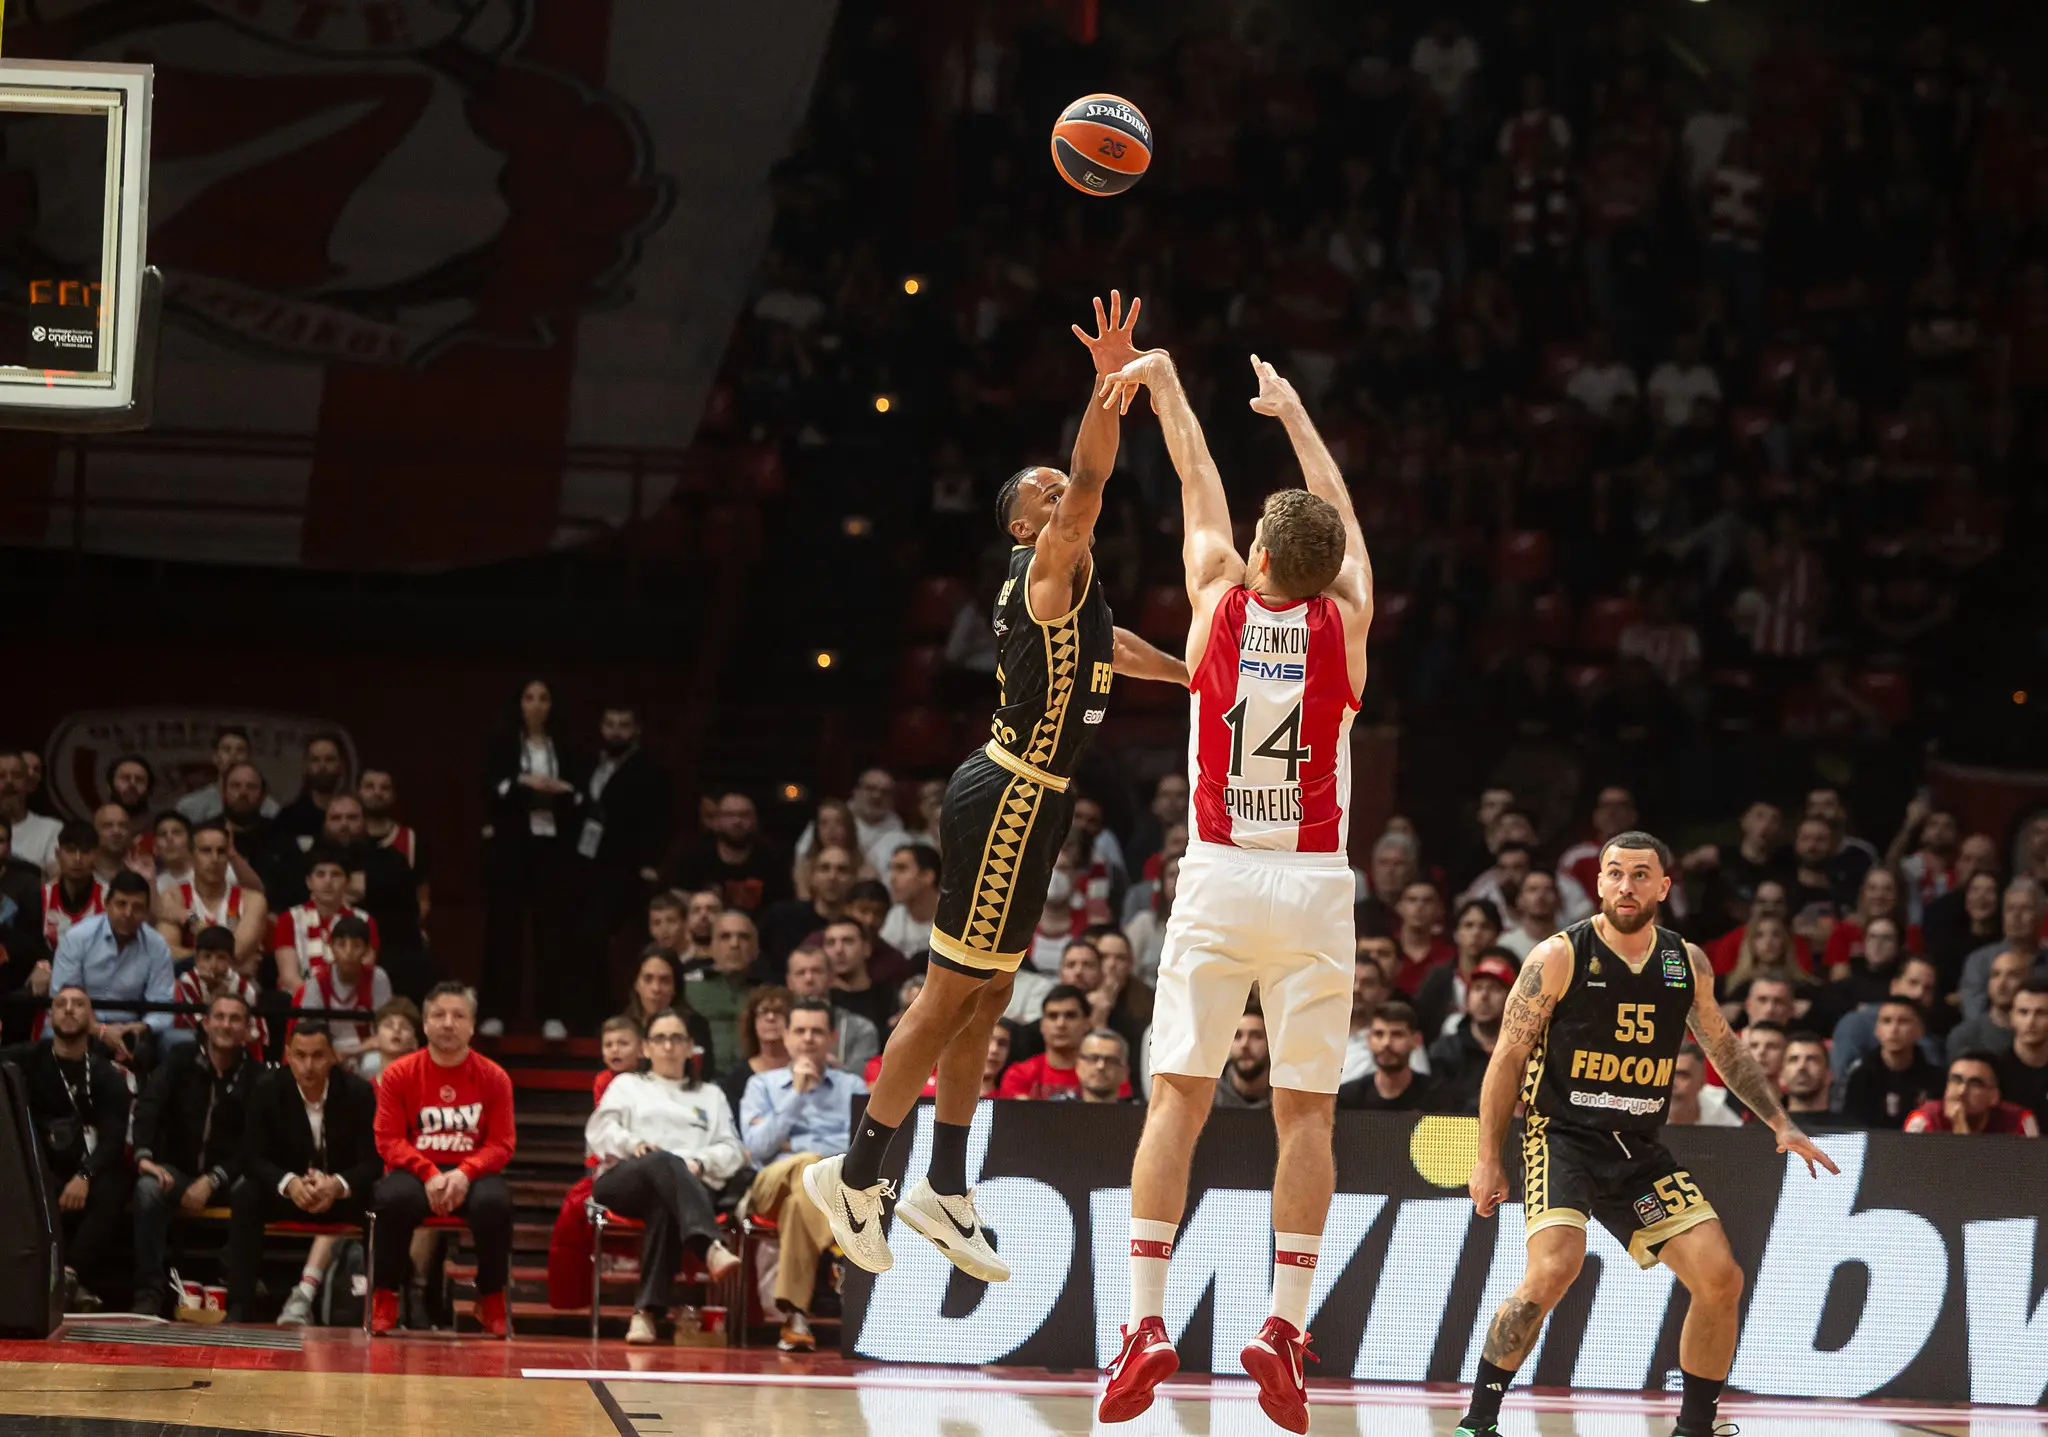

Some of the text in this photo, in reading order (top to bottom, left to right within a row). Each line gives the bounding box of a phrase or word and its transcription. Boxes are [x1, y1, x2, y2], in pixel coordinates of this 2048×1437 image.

[1086, 103, 1149, 143] SPALDING
[48, 332, 93, 344] oneteam
[1241, 623, 1310, 655] VEZENKOV
[1240, 659, 1305, 681] FMS
[1222, 696, 1311, 783] 14
[1223, 787, 1304, 822] PIRAEUS
[1615, 1003, 1655, 1044] 55
[1652, 1171, 1704, 1215] 55
[853, 1098, 1677, 1391] bwin
